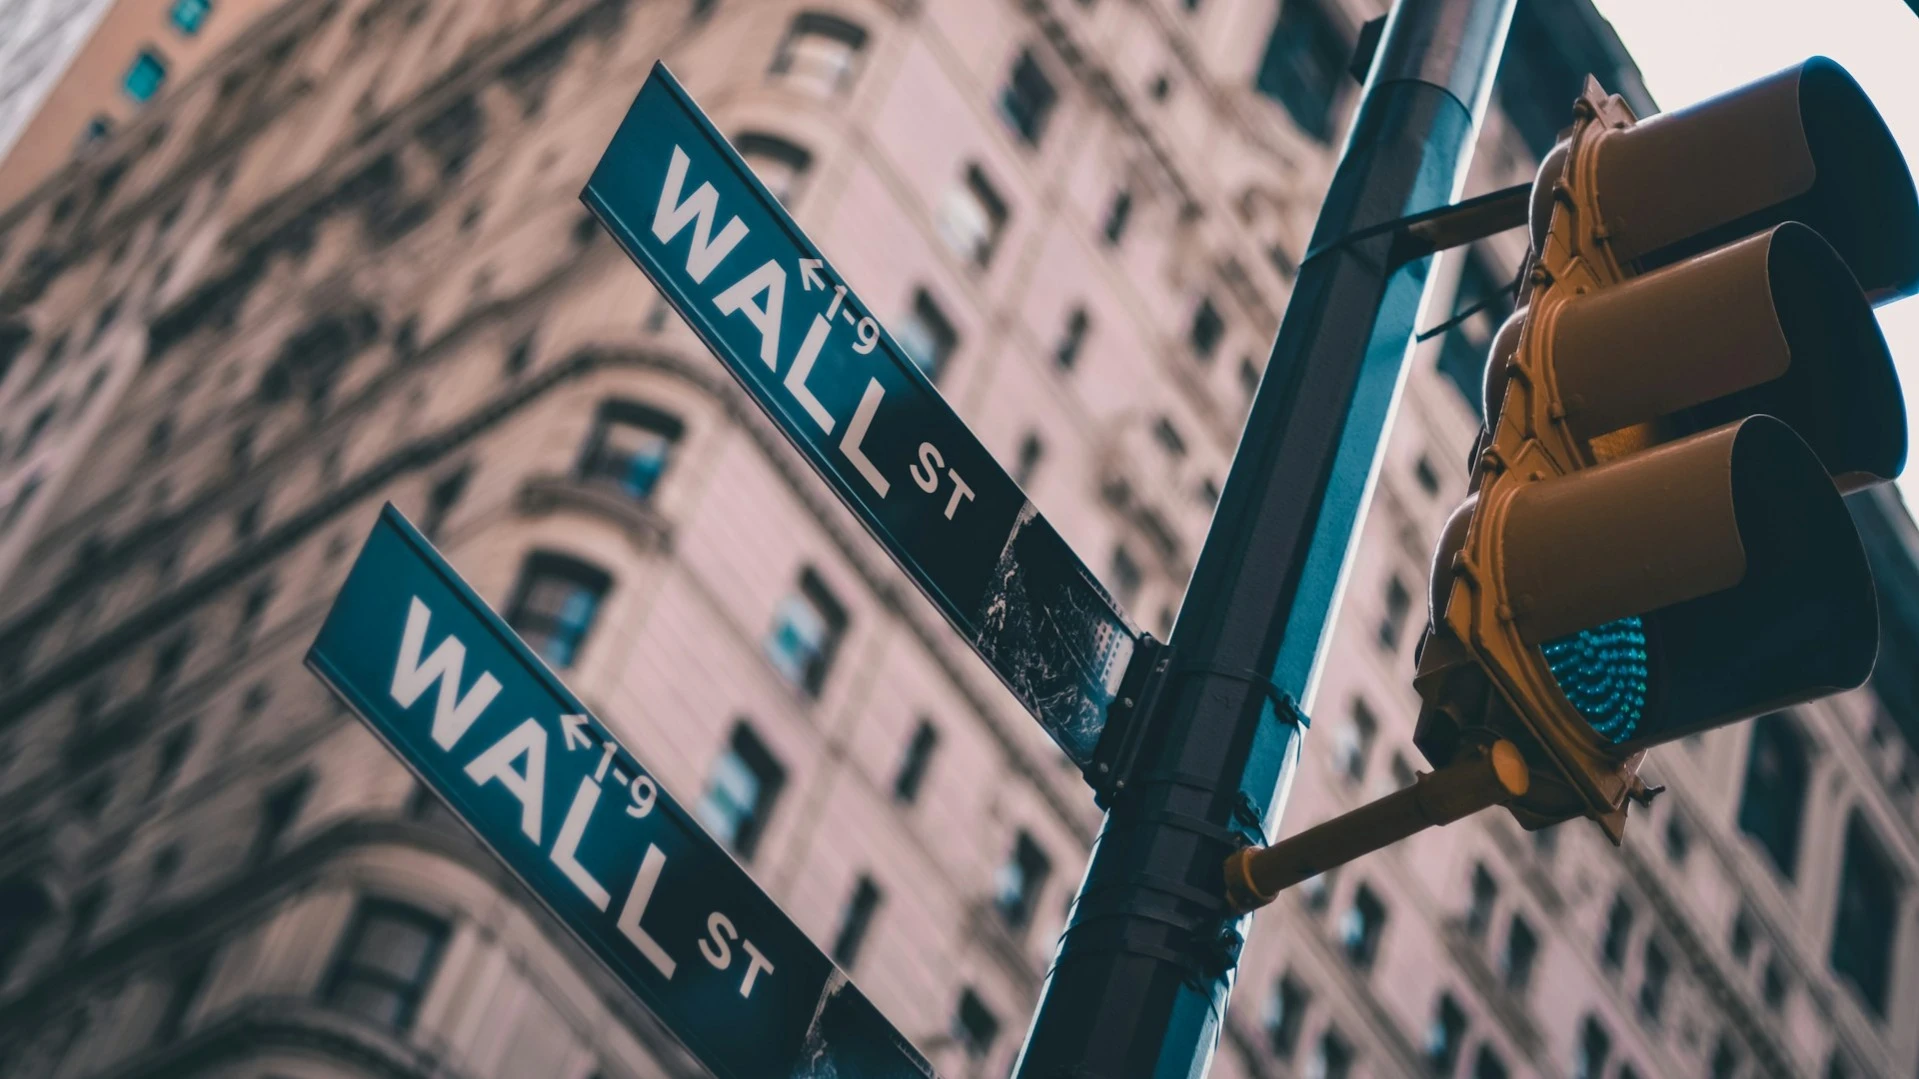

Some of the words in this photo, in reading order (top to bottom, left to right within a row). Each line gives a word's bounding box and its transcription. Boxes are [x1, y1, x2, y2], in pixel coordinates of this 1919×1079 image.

[651, 143, 891, 500] WALL
[909, 441, 976, 521] ST
[824, 283, 881, 356] 1-9
[389, 594, 677, 981] WALL
[698, 911, 776, 999] ST
[594, 740, 658, 819] 1-9
